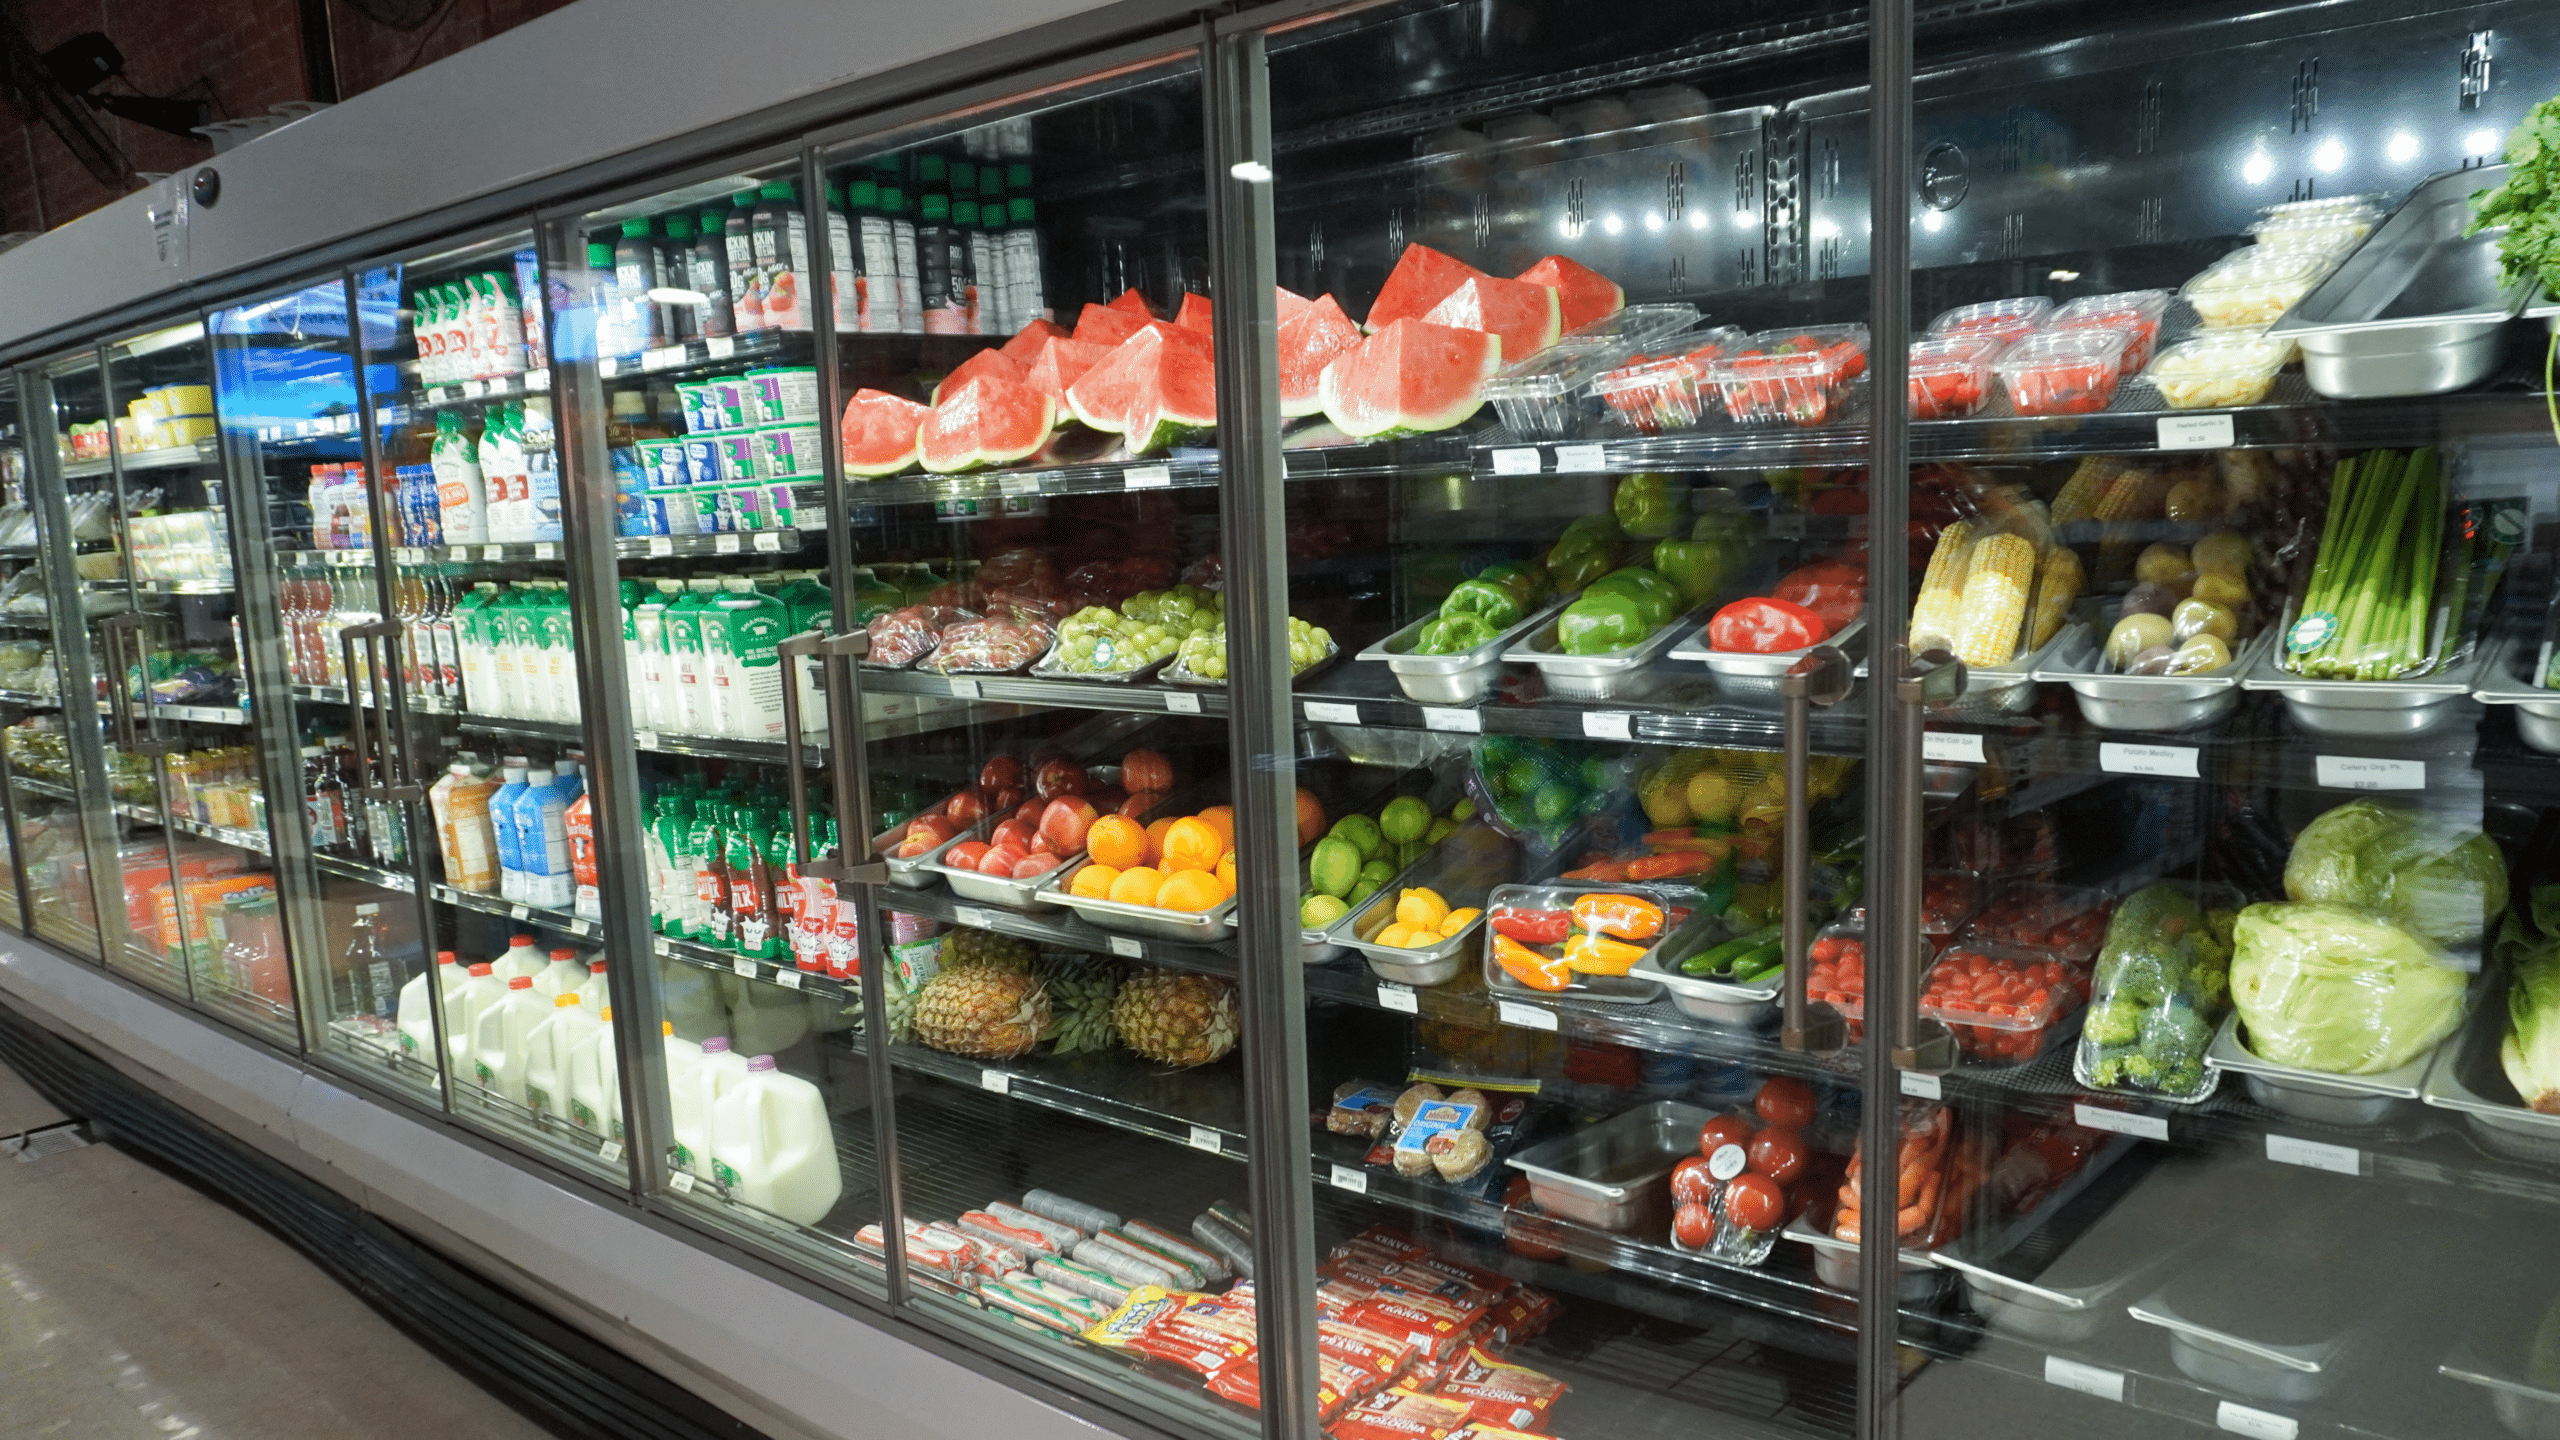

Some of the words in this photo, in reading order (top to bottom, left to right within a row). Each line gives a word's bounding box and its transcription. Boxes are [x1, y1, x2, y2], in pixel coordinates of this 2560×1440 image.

[741, 617, 779, 632] SHAMROCK
[806, 610, 833, 625] SHAMRO
[2123, 747, 2147, 756] Potato
[2149, 749, 2176, 759] Medley
[1411, 1120, 1446, 1130] ORIGINAL
[1428, 1259, 1475, 1280] FRANKS
[1377, 1303, 1428, 1323] FRANKS
[1319, 1335, 1372, 1357] FRANKS
[1461, 1386, 1526, 1404] BOLOGNA
[1361, 1414, 1426, 1435] BOLOGNA
